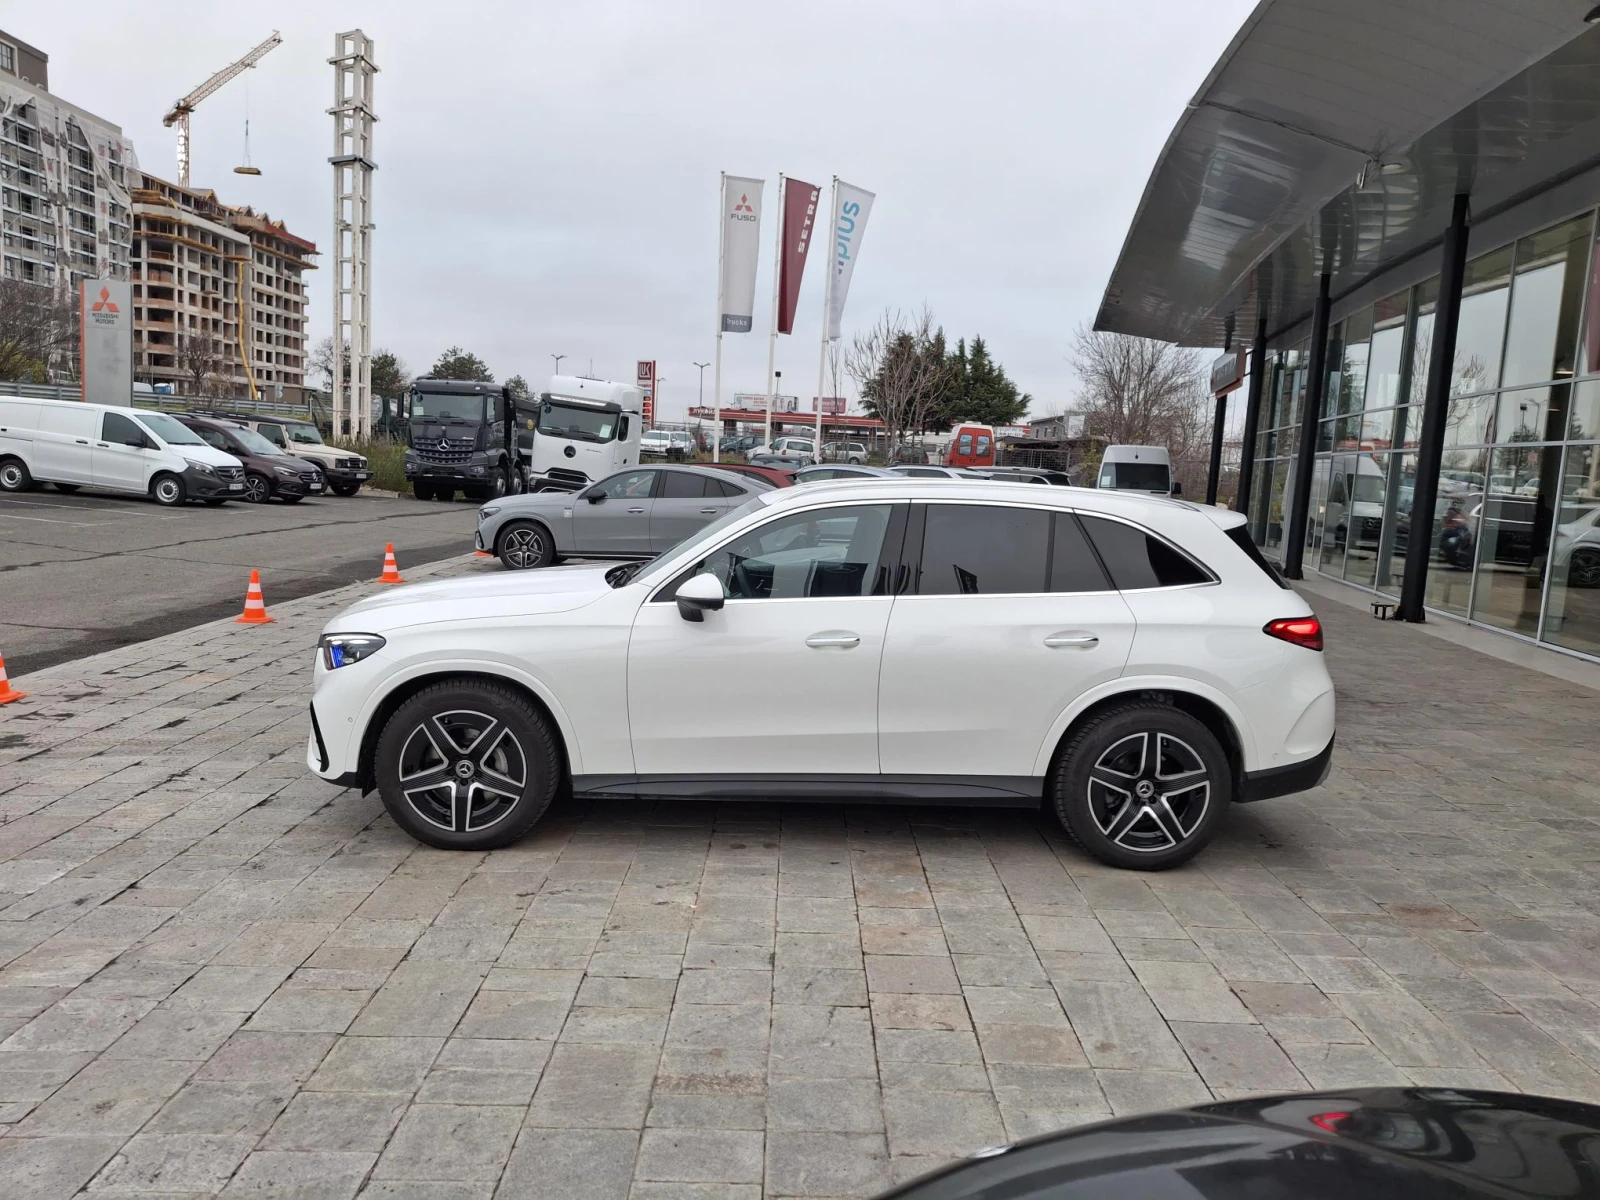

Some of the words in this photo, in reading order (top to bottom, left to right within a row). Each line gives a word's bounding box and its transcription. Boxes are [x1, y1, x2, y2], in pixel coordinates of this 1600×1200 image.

[730, 213, 757, 222] FUSO
[798, 190, 819, 253] SETRA
[726, 317, 748, 326] Trucks
